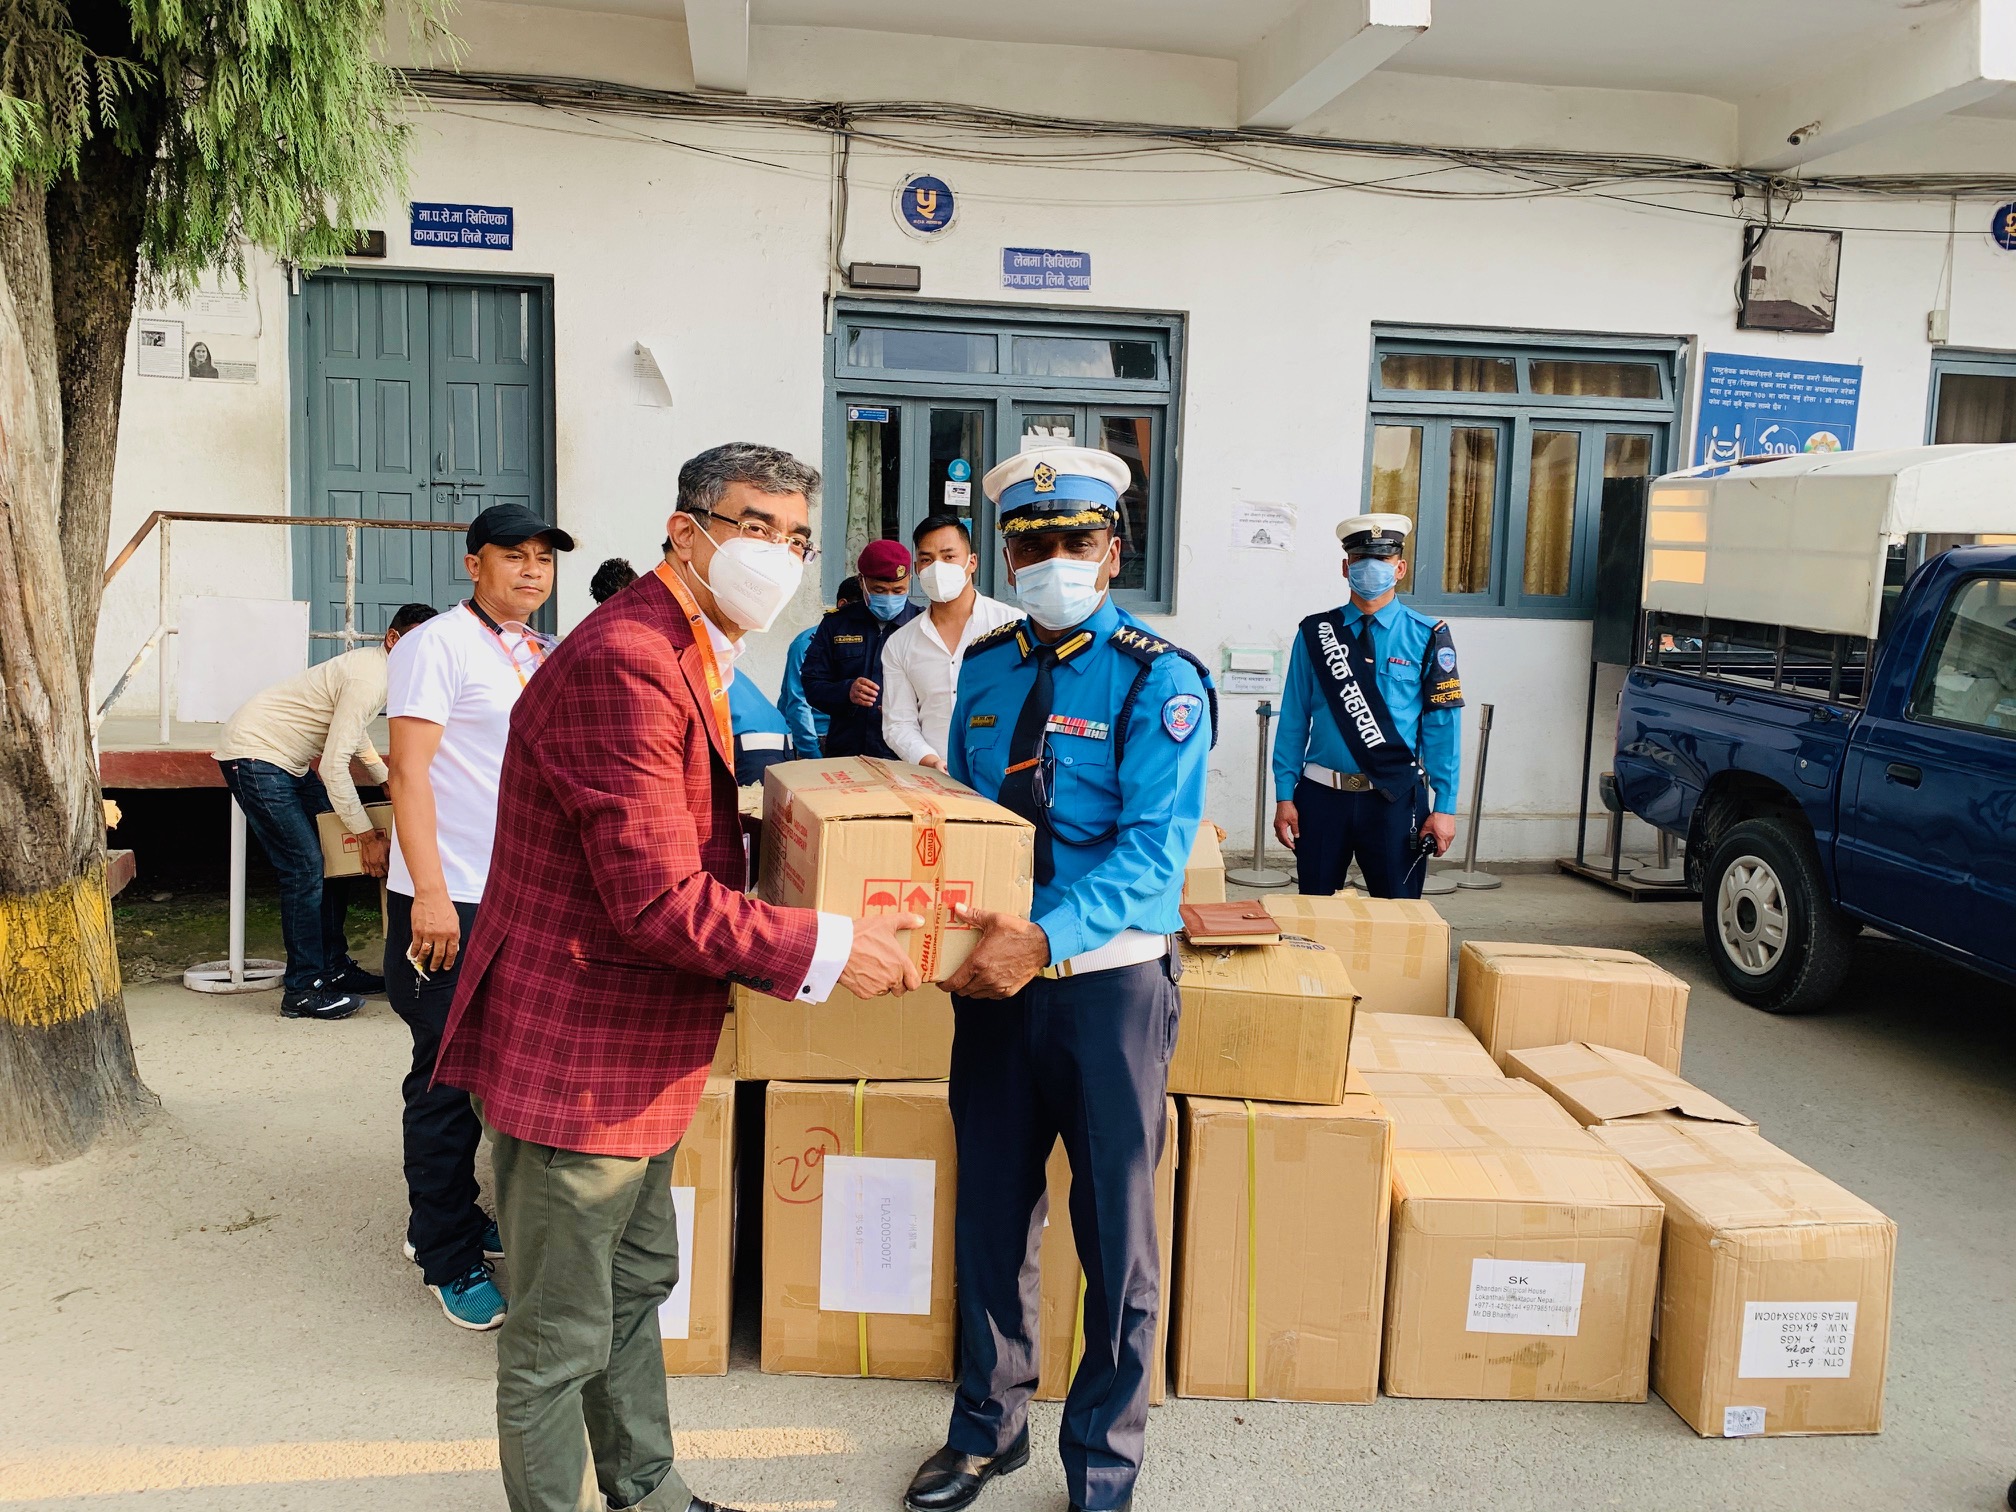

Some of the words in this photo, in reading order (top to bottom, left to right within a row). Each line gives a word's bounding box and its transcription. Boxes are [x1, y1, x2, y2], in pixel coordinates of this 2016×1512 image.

[466, 208, 508, 226] खिचिएका
[413, 229, 458, 243] कागजपत्र
[461, 228, 482, 244] लिने
[485, 233, 510, 246] स्थान
[1014, 254, 1041, 268] लेनमा
[1043, 253, 1083, 269] खिचिएका
[1002, 273, 1043, 286] कागजपत्र
[1045, 271, 1065, 287] लिने
[1067, 275, 1091, 287] स्थान
[1318, 621, 1354, 680] नागरिक
[1339, 681, 1386, 749] सहायता
[880, 1197, 892, 1269] FLA2005007E
[1528, 1287, 1547, 1295] House
[1782, 1324, 1803, 1333] KGS
[1780, 1335, 1801, 1344] KGS
